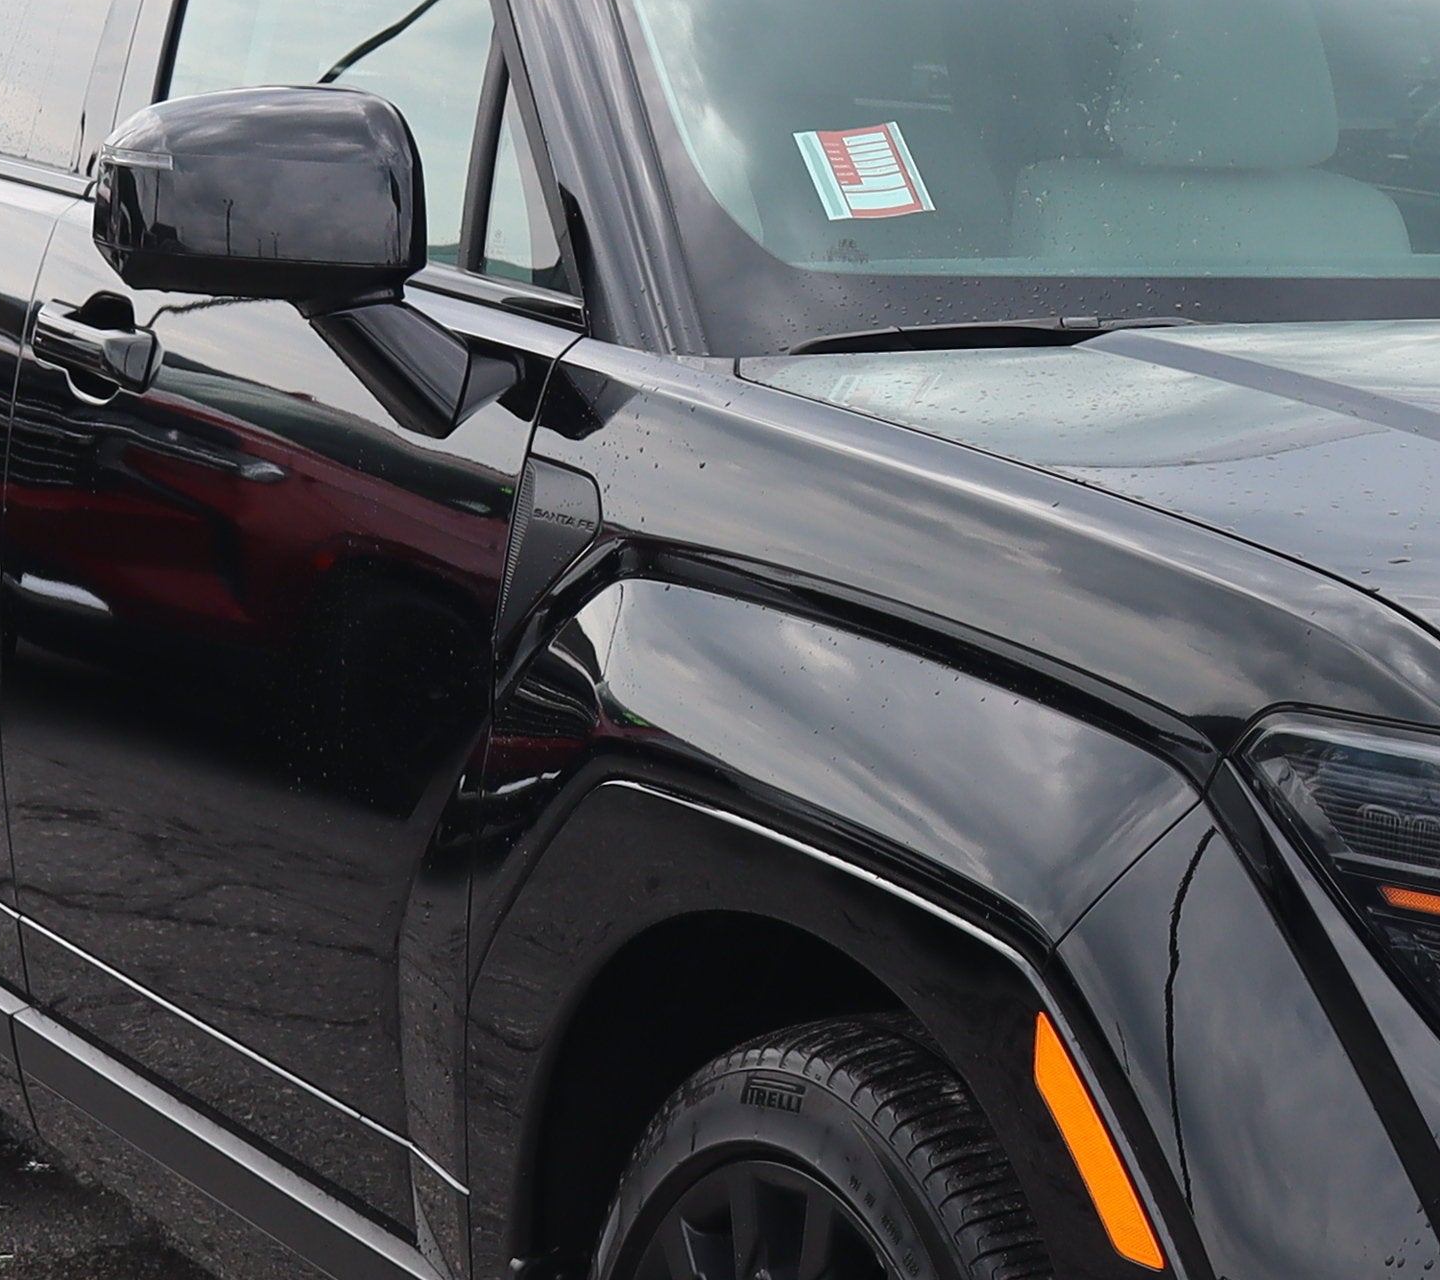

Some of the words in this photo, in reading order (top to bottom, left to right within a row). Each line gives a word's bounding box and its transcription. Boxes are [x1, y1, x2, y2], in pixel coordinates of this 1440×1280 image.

[533, 508, 574, 526] SANTA
[575, 519, 595, 532] FE
[740, 1075, 807, 1114] PIRELLI
